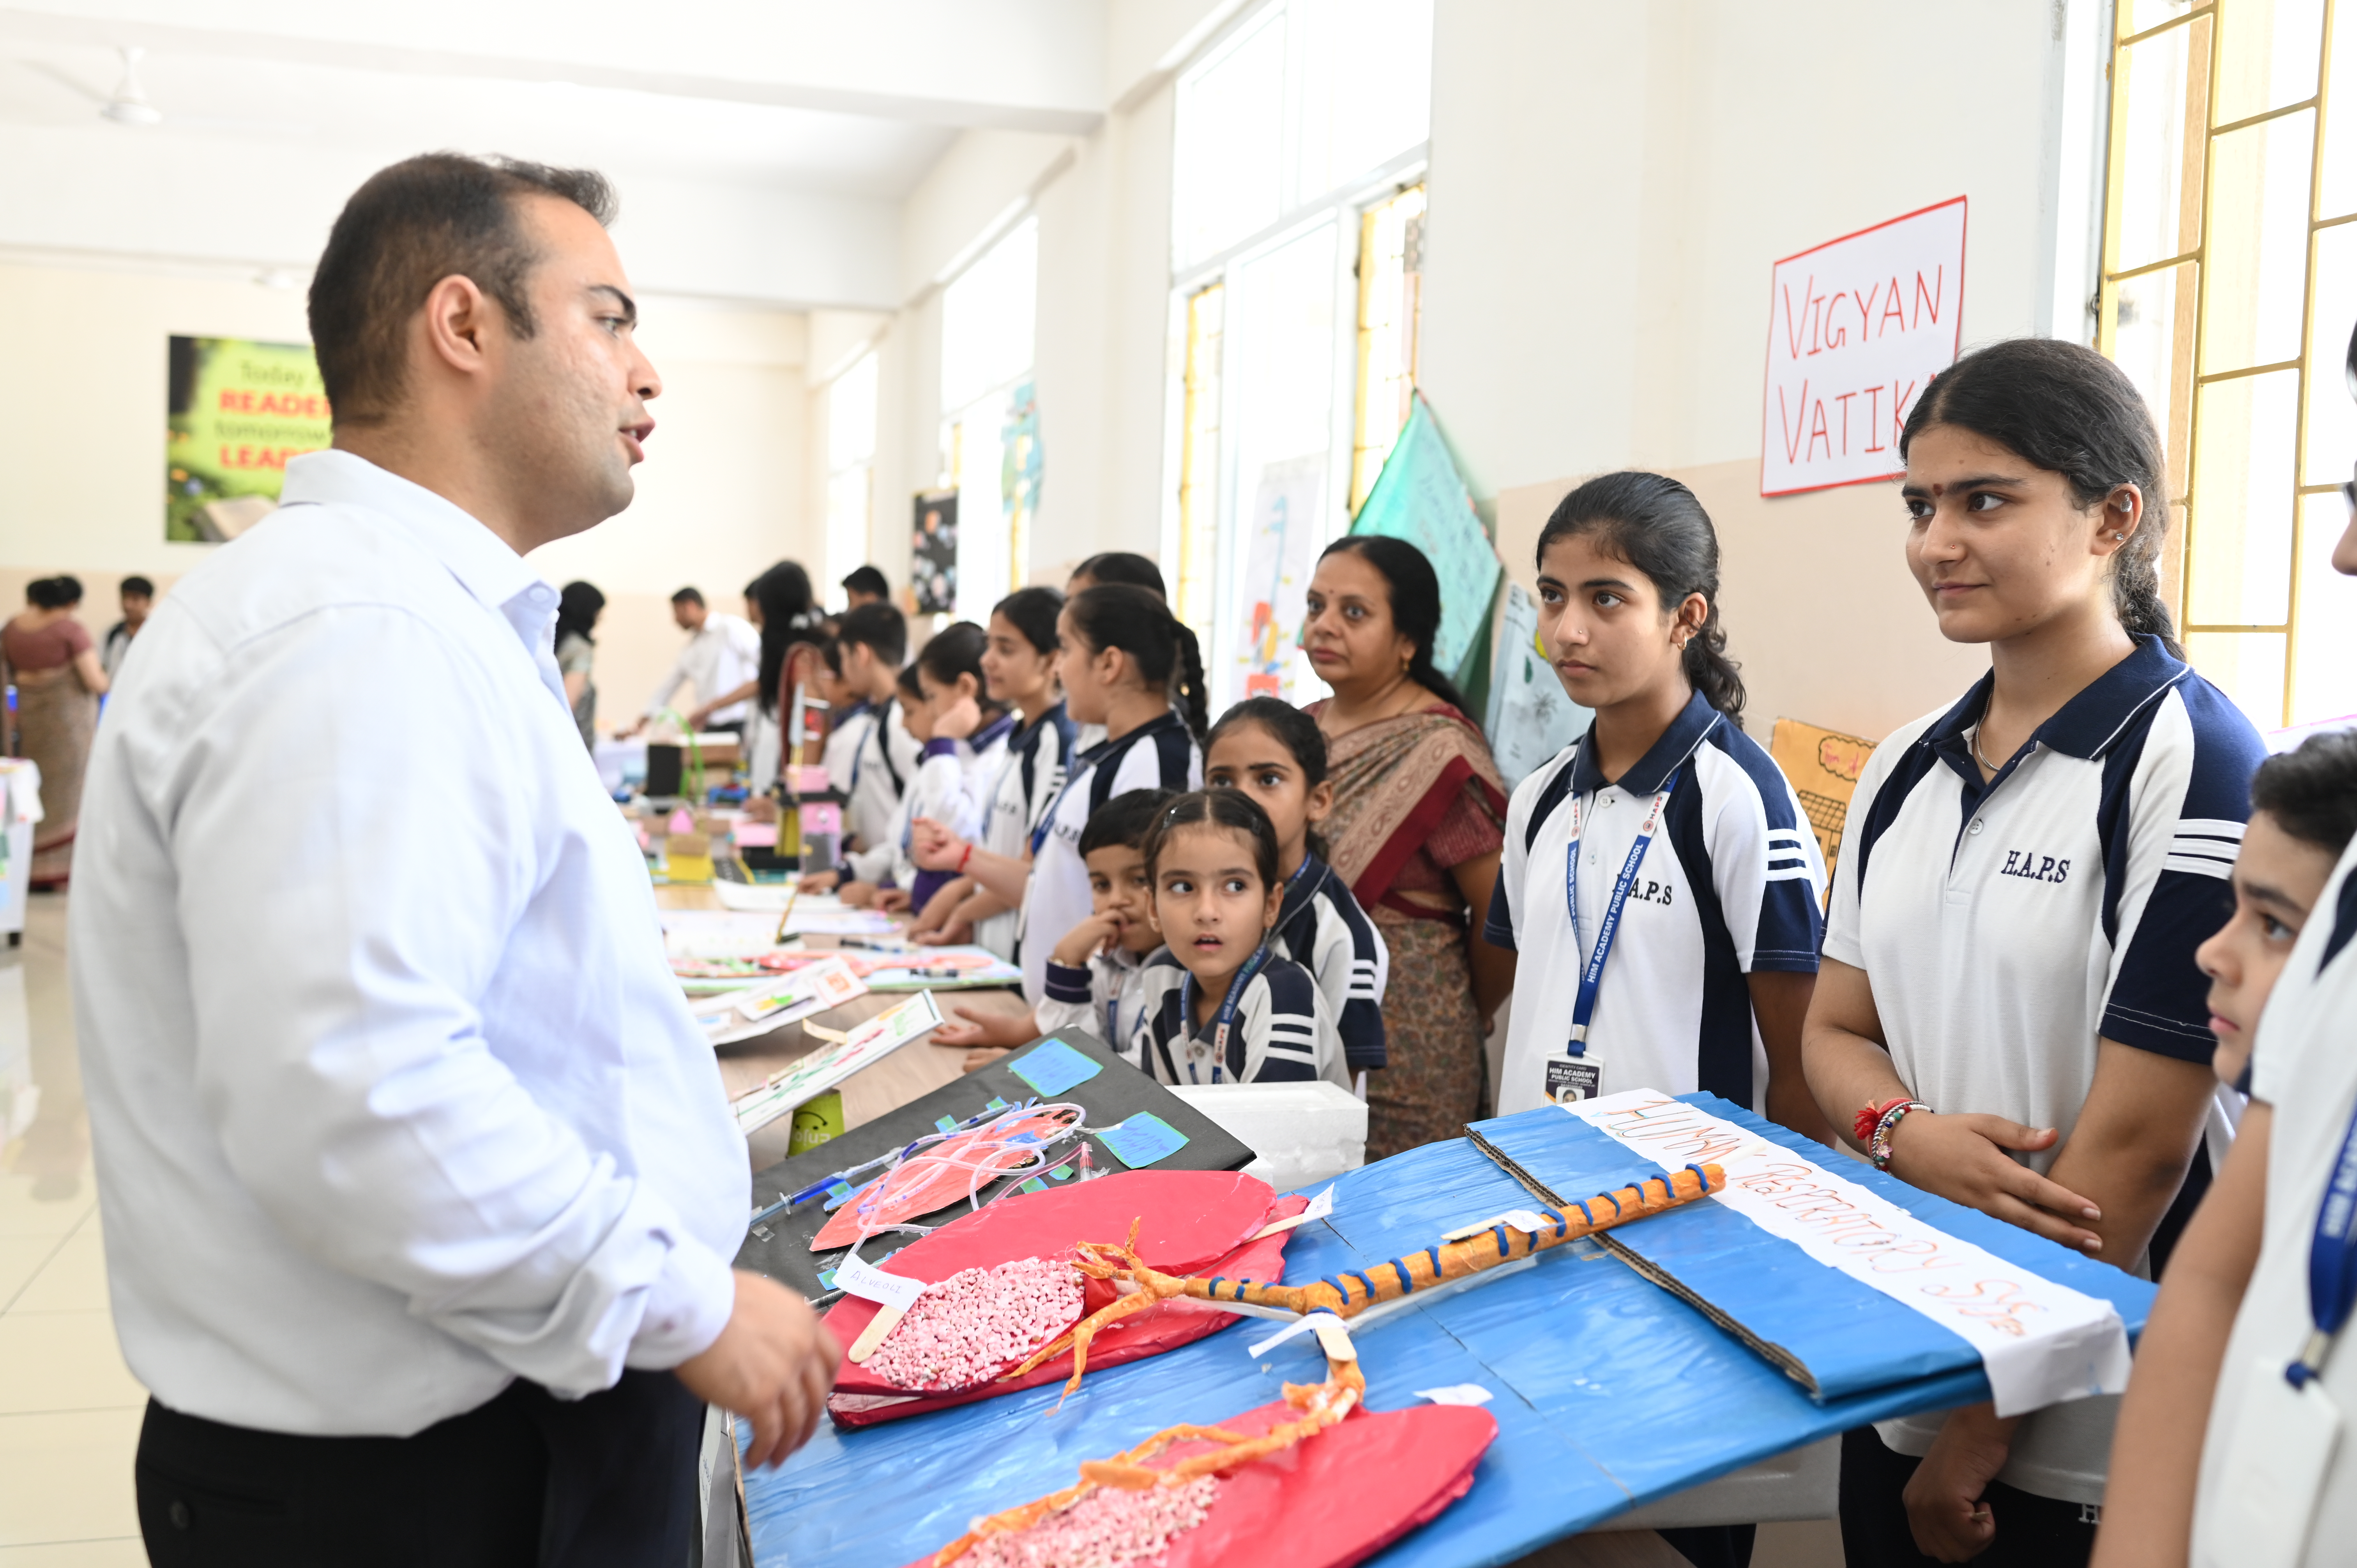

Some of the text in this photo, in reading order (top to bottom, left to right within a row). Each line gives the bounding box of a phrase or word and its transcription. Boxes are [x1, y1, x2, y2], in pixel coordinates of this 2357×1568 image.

[1783, 264, 1943, 360] VIGYAN
[240, 359, 304, 389] Today
[1779, 373, 1937, 464] VATIK
[219, 443, 316, 471] LEAD
[1587, 844, 1643, 983] HIM ACADEMY PUBLIC SCHOOL
[1563, 1070, 1596, 1079] ACADEMY
[1730, 1164, 1963, 1273] RESPIRATORY
[850, 1271, 902, 1294] ALVEOLI
